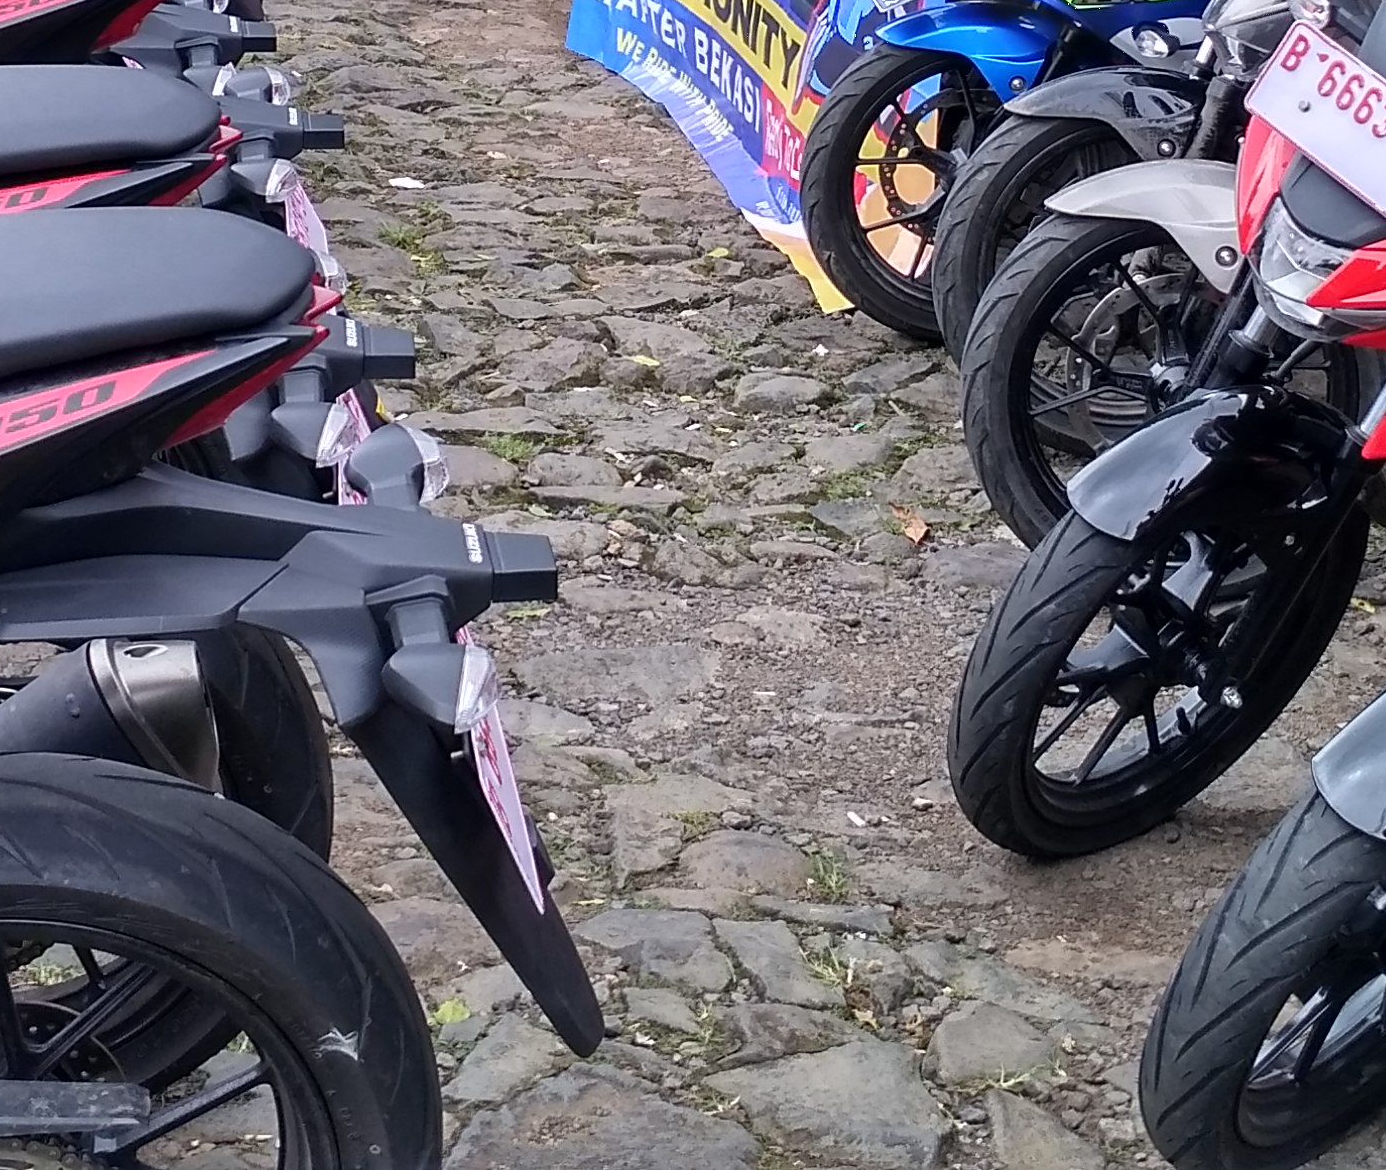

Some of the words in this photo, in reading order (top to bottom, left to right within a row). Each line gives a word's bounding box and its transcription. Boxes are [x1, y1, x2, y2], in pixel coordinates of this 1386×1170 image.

[616, 27, 645, 62] WE
[1280, 33, 1312, 72] B
[694, 27, 762, 133] BEKASI
[462, 523, 483, 563] SUZUKI
